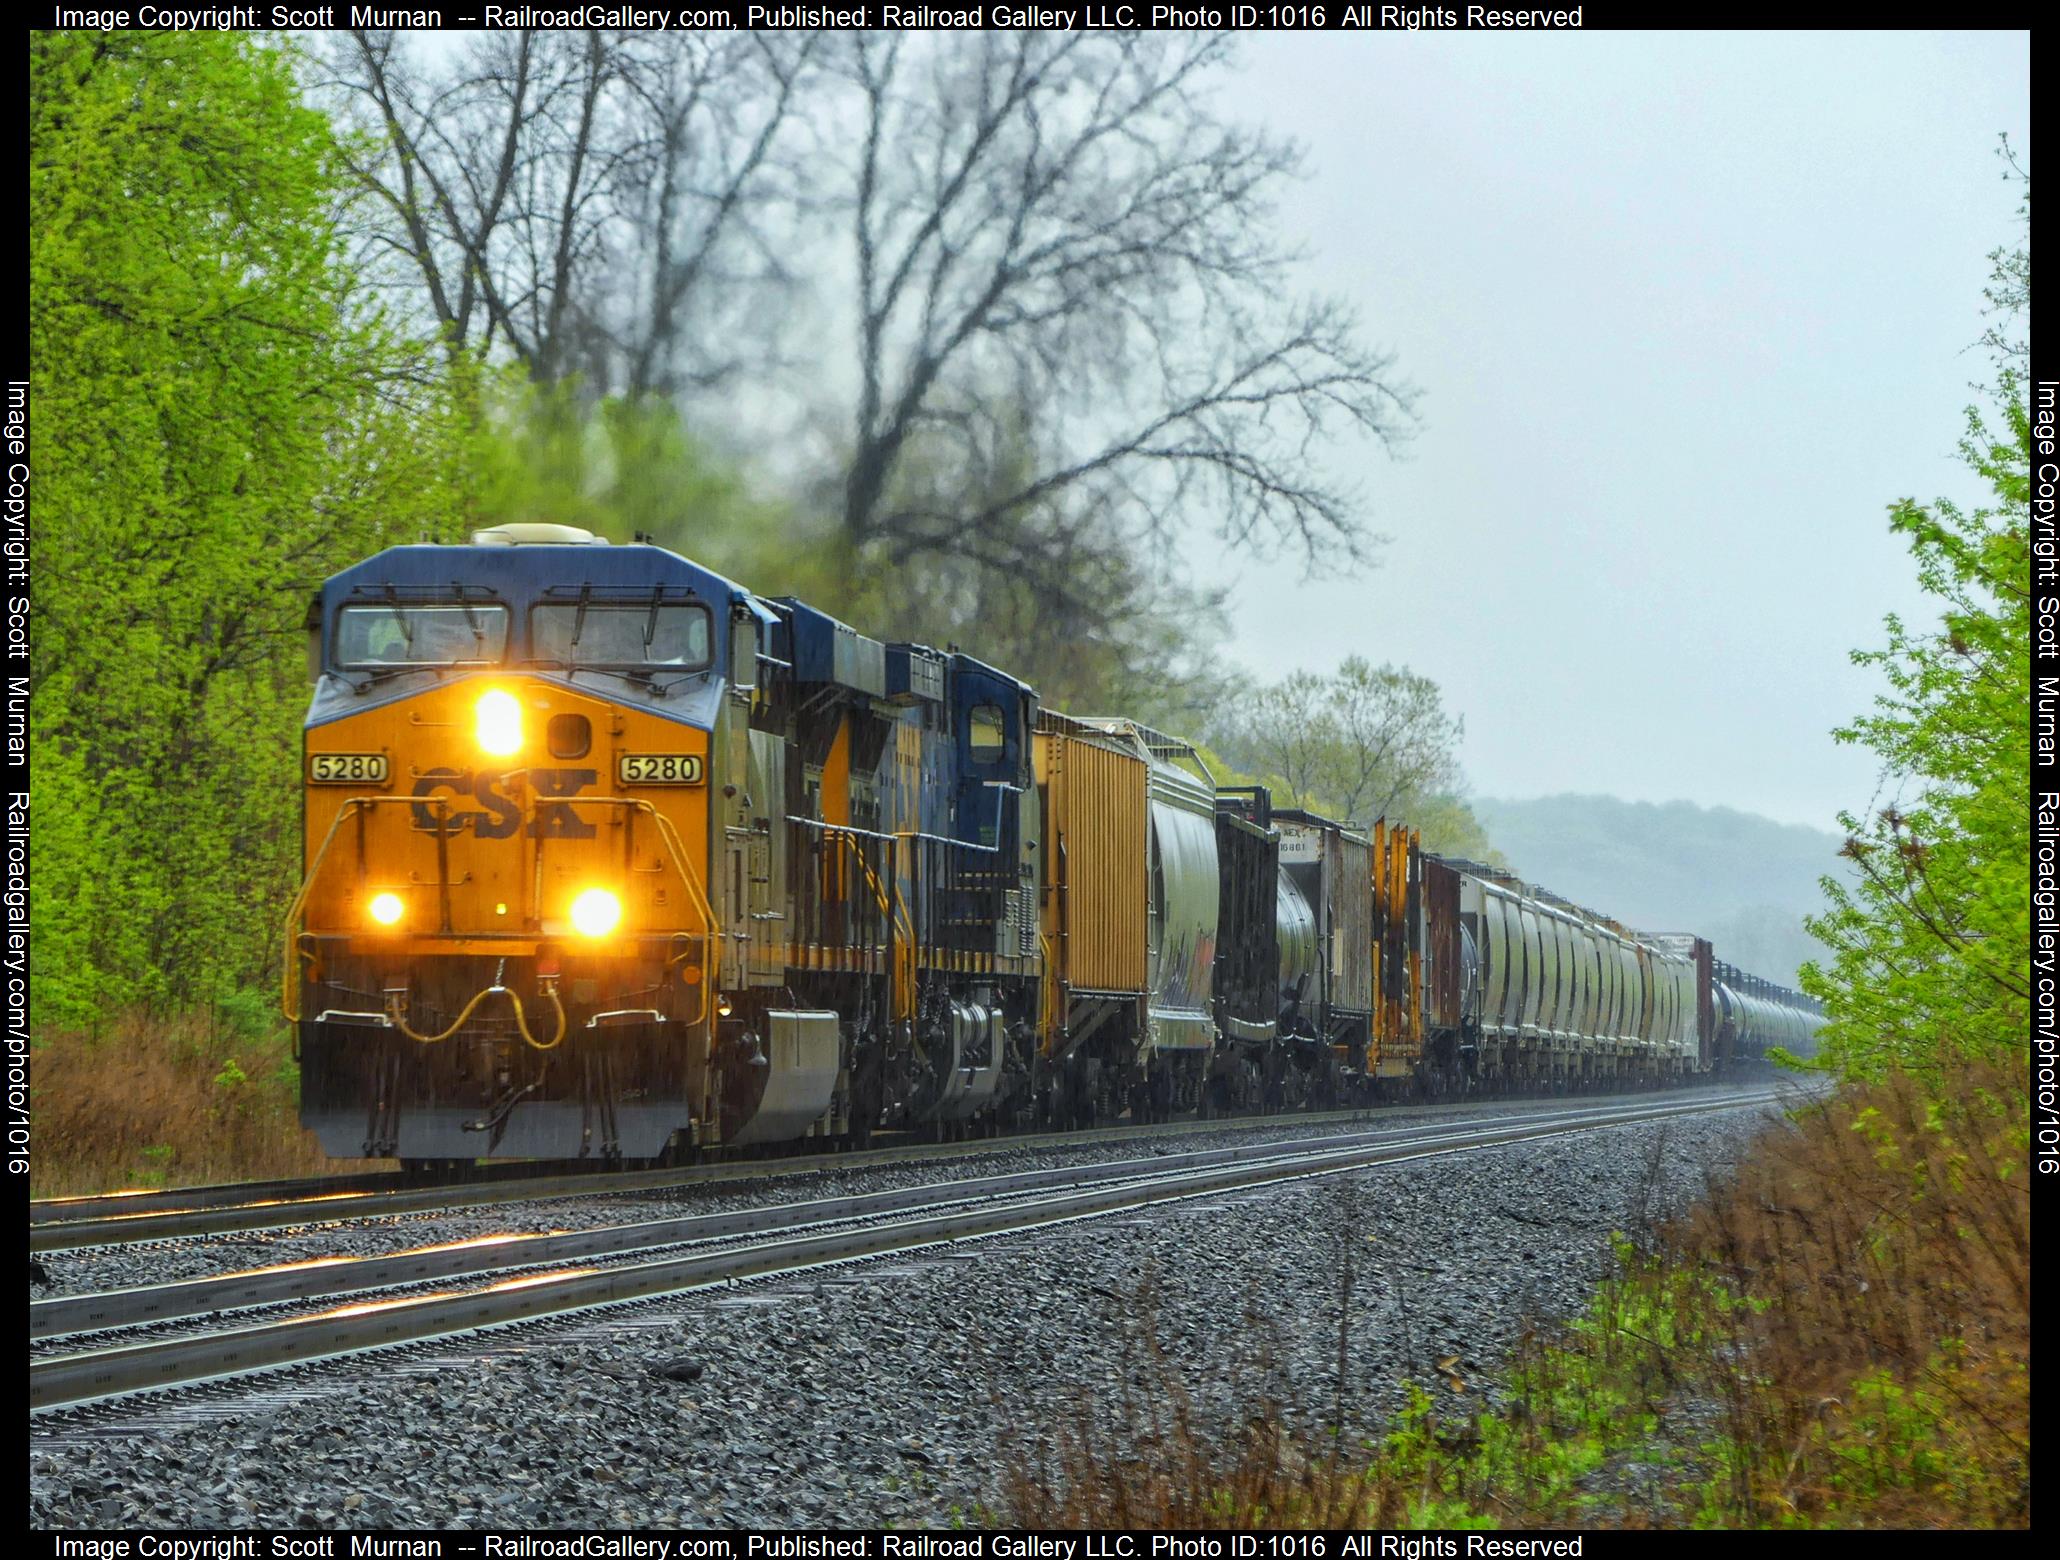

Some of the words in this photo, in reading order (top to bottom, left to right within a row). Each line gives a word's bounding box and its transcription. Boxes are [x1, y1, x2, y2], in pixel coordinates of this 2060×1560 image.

[317, 756, 382, 779] 5280
[626, 757, 696, 780] 5280
[411, 767, 597, 839] CSX
